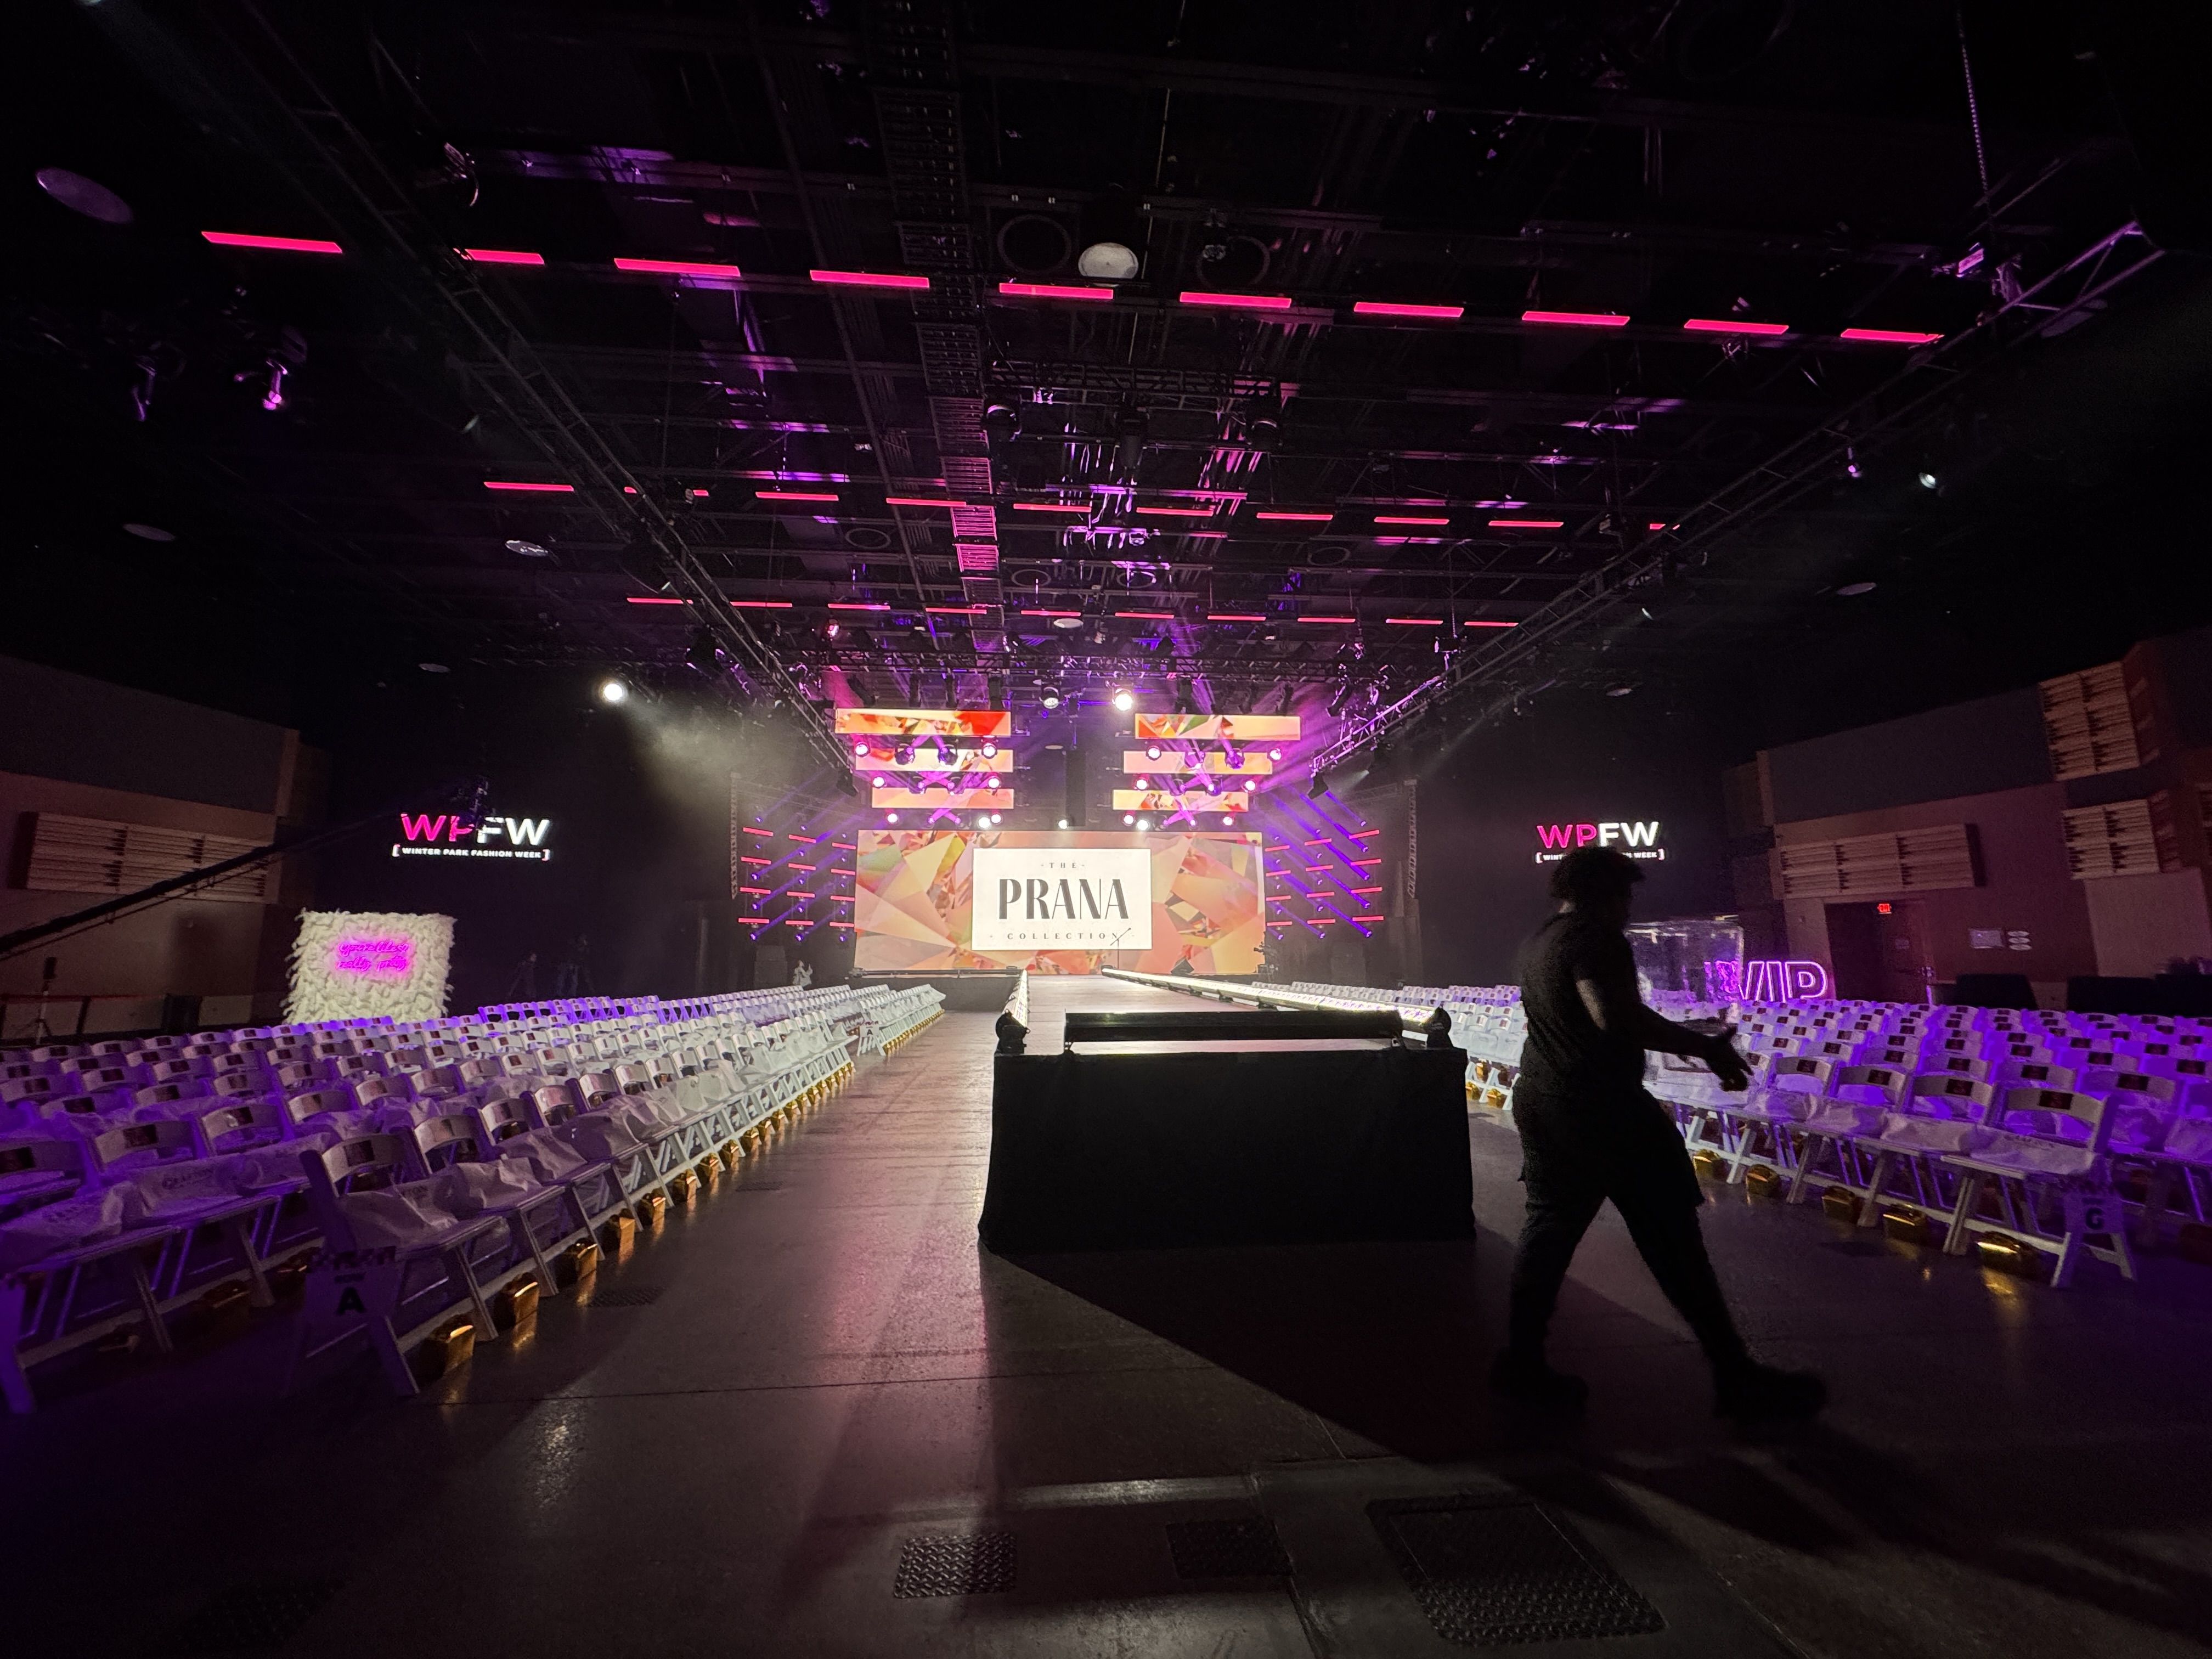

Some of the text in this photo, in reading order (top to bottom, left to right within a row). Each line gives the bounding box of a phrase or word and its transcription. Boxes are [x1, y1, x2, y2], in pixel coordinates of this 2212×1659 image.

[400, 813, 550, 846] WPFW
[1537, 821, 1660, 849] WPFW
[998, 879, 1128, 919] PRANA
[1716, 961, 1829, 1003] VIP
[2086, 1207, 2106, 1229] G
[336, 1287, 368, 1314] A
